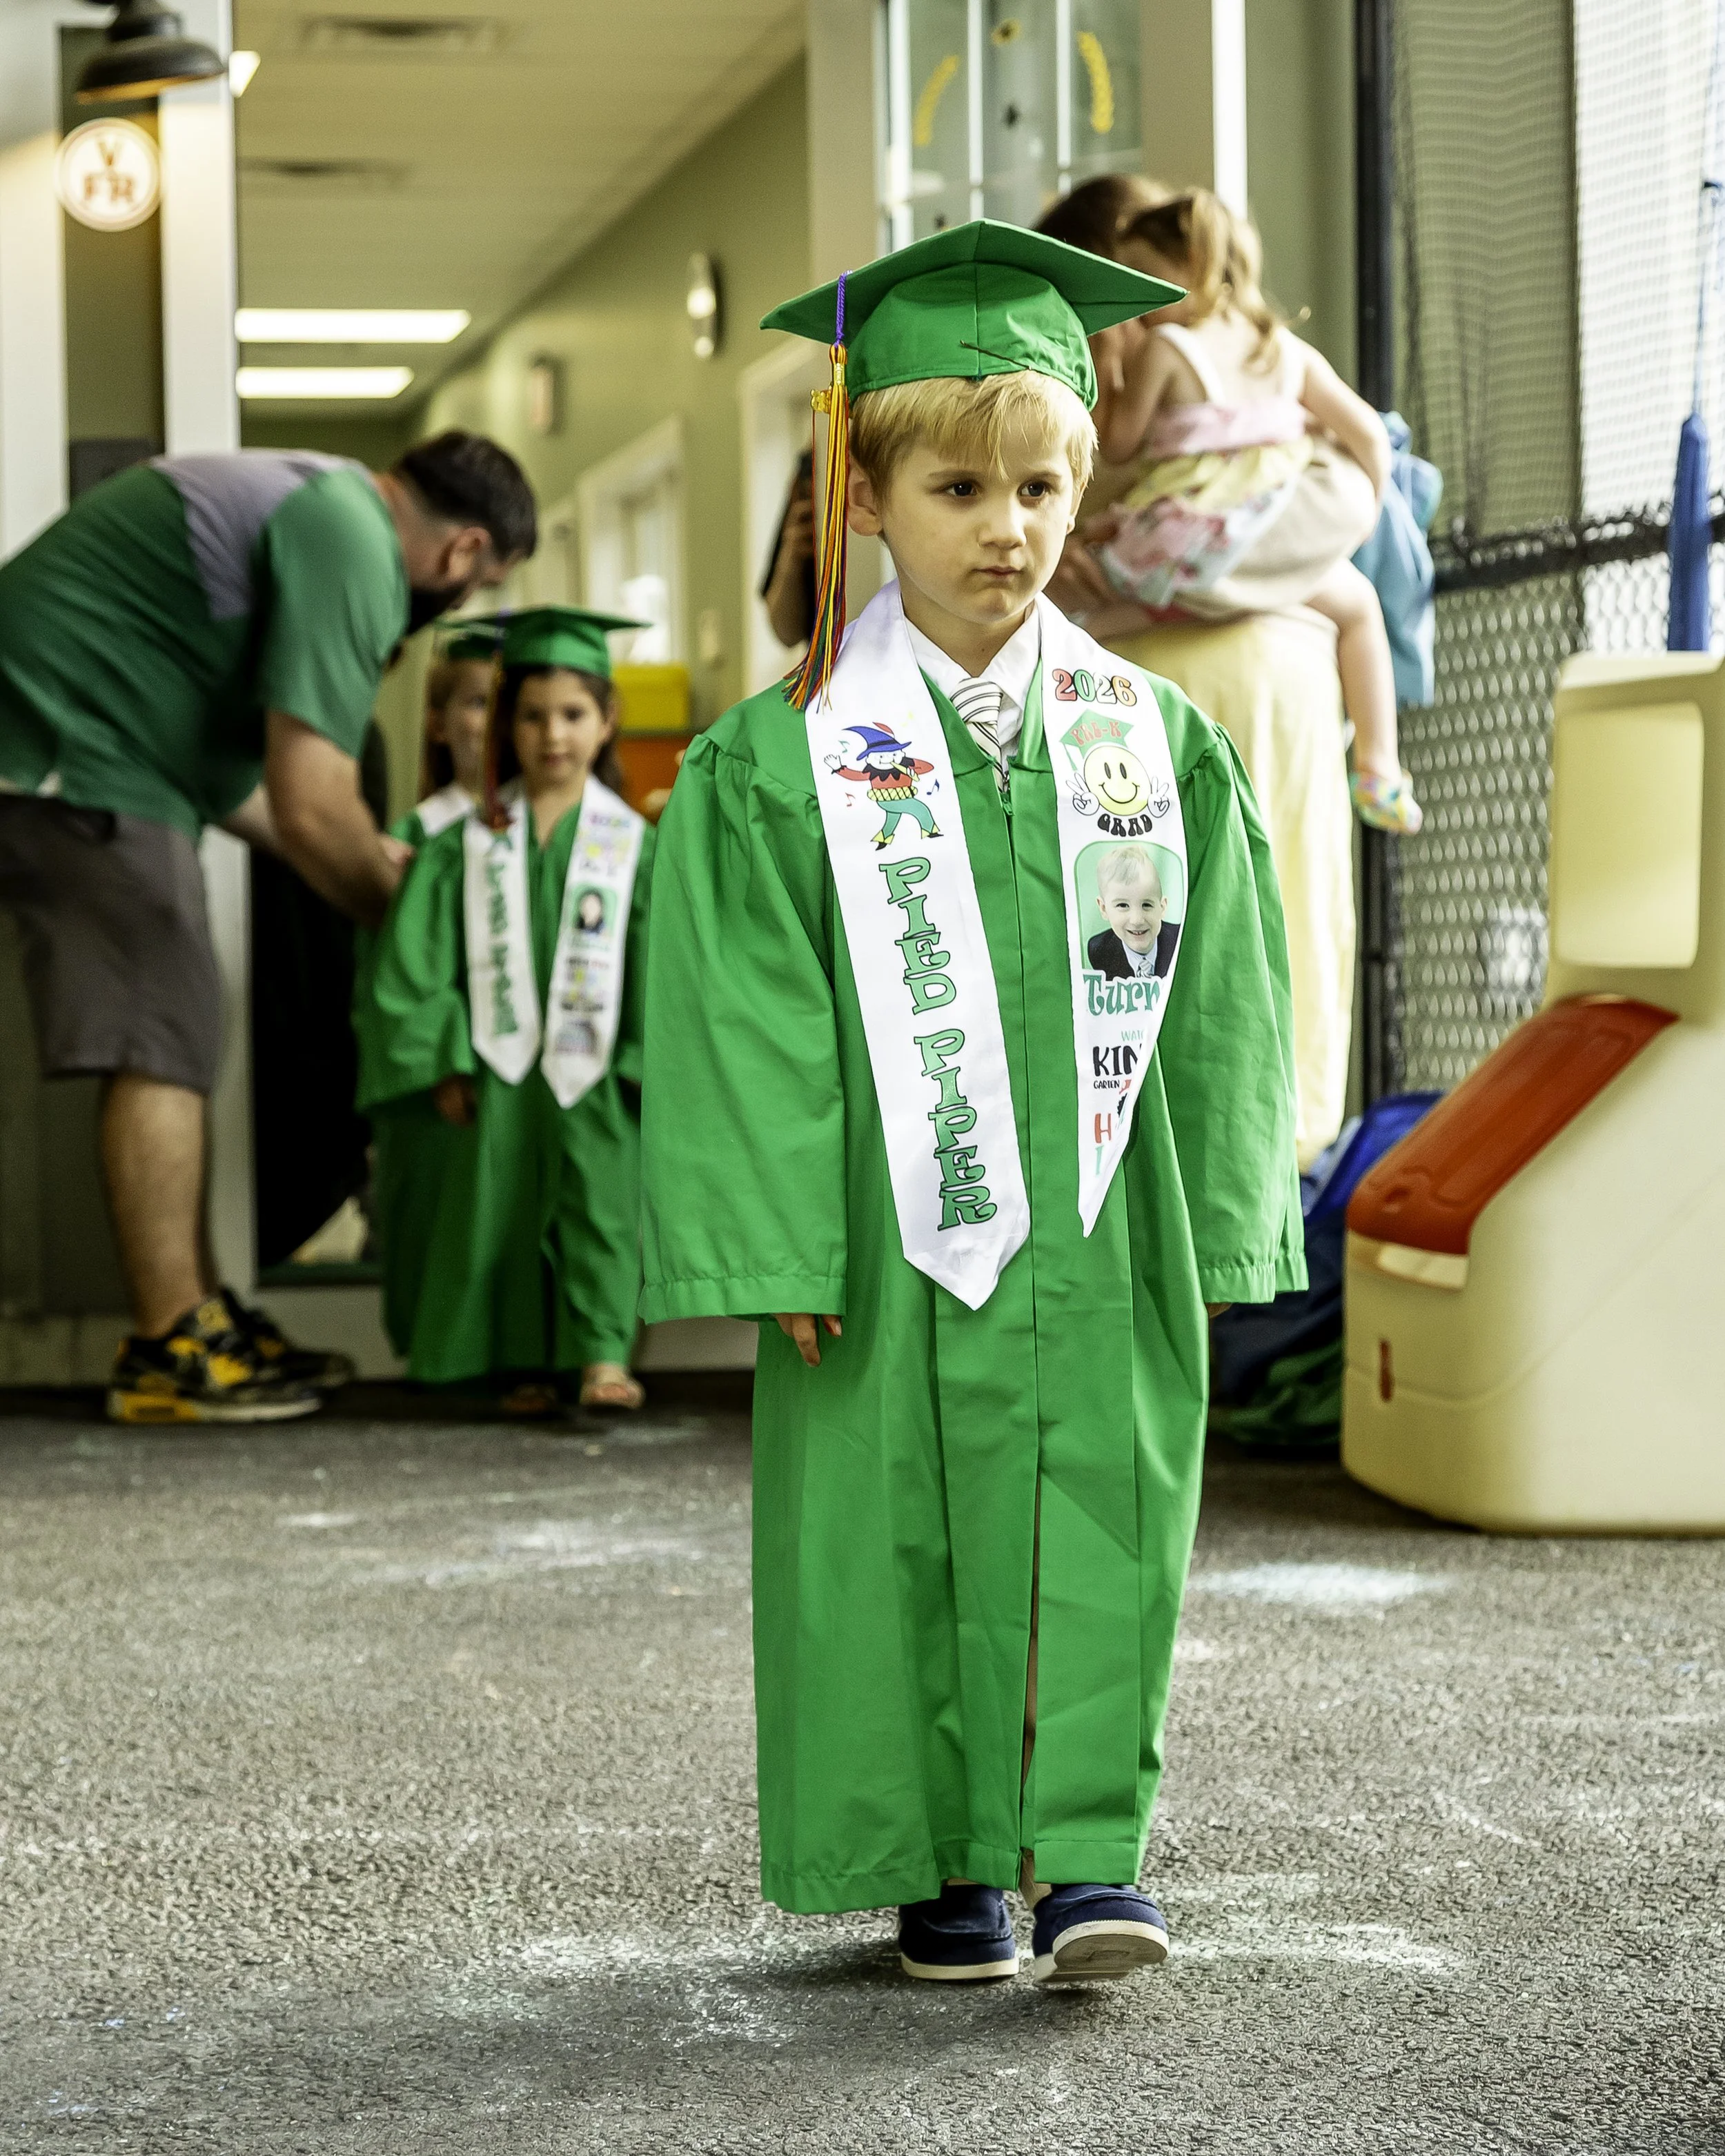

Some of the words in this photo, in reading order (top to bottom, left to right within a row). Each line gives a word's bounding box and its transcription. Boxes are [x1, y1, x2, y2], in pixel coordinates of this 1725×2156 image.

[1052, 668, 1137, 706] 2026
[1070, 721, 1121, 746] PRE-K
[1097, 813, 1152, 837] GRAD
[878, 856, 957, 1016] PIED
[1094, 1079, 1120, 1089] GARTEN
[914, 1028, 998, 1232] PIPER
